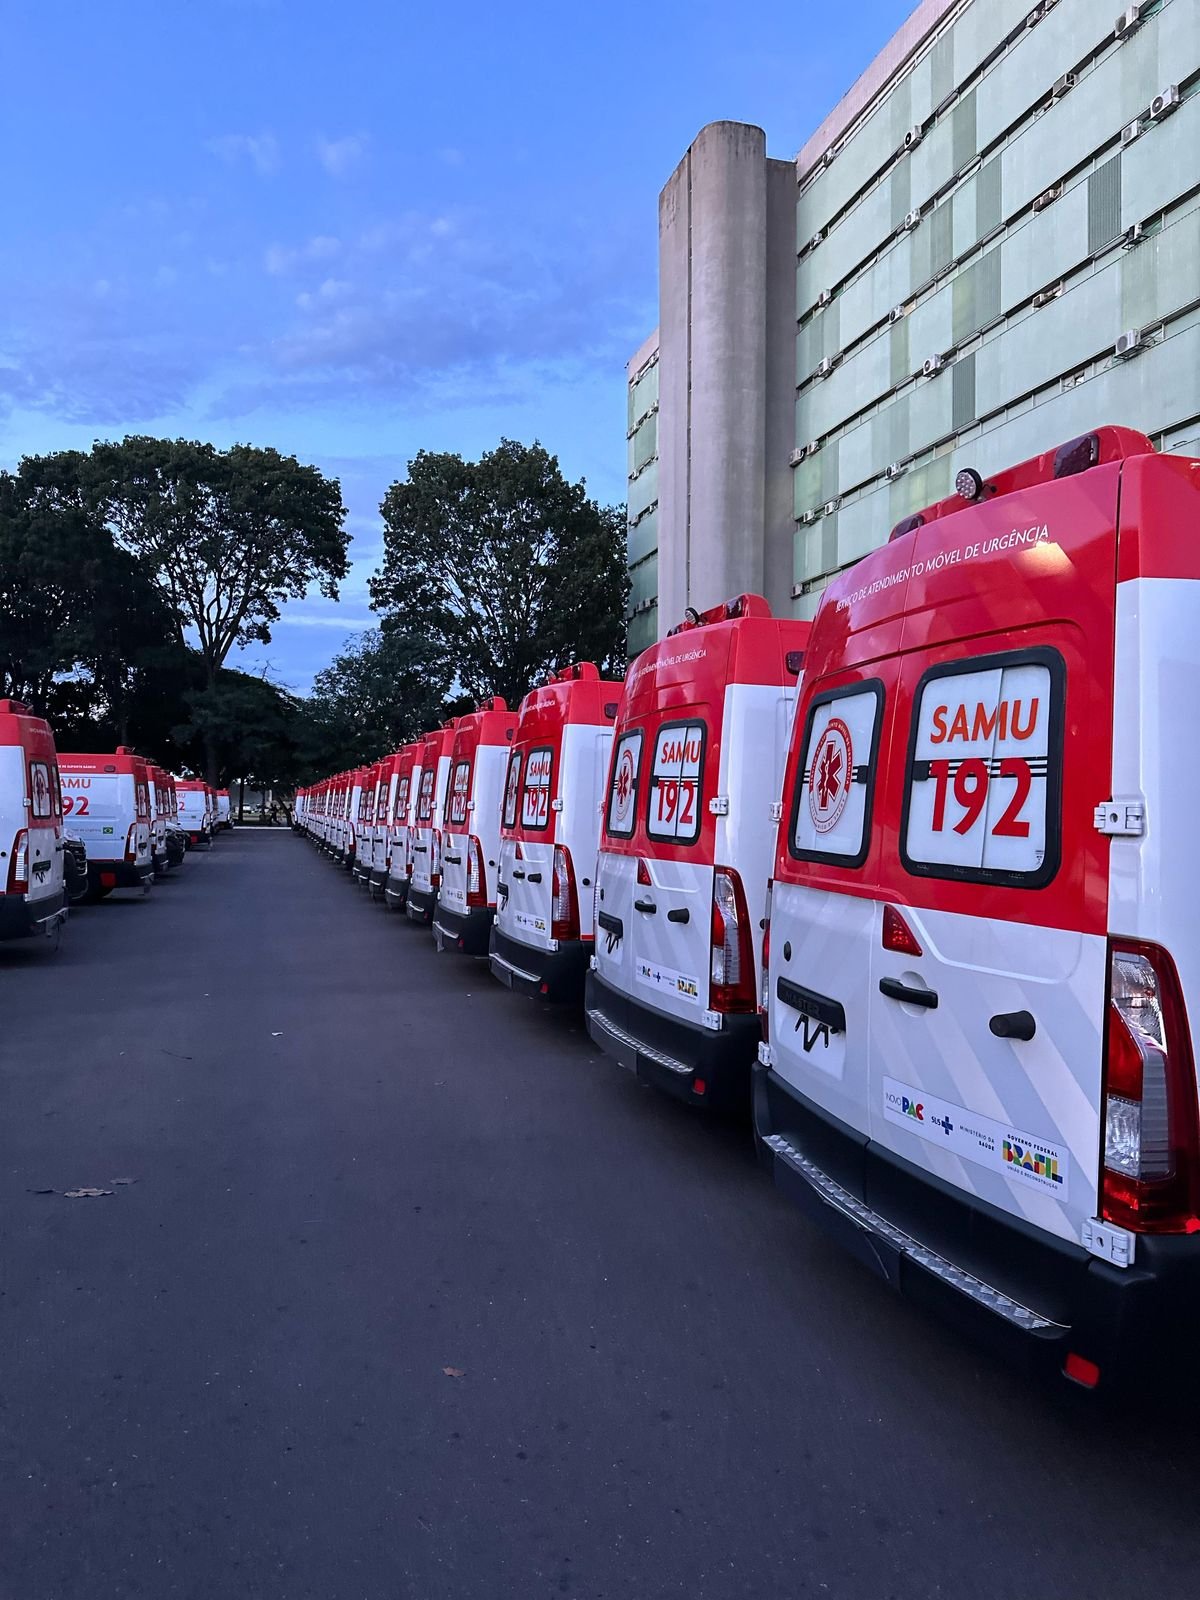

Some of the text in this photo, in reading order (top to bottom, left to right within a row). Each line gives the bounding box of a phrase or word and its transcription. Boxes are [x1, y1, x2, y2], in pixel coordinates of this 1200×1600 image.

[858, 587, 867, 600] DE
[867, 562, 924, 595] ATENDIMENTO
[926, 550, 961, 571] MÓVEL
[964, 543, 979, 563] DE
[983, 524, 1049, 554] URGÊNCIA
[930, 698, 1039, 743] SAMU
[661, 741, 701, 764] SAMU
[60, 778, 91, 788] AMU
[62, 796, 89, 815] 92
[527, 787, 547, 816] 192
[658, 779, 694, 824] 192
[929, 758, 1032, 838] 192
[902, 1096, 924, 1120] PAC
[978, 1141, 995, 1152] SAÚDE
[988, 1136, 995, 1144] DA
[1007, 1134, 1058, 1158] GOVERNO FEDERAL
[1003, 1140, 1063, 1184] BRASIL
